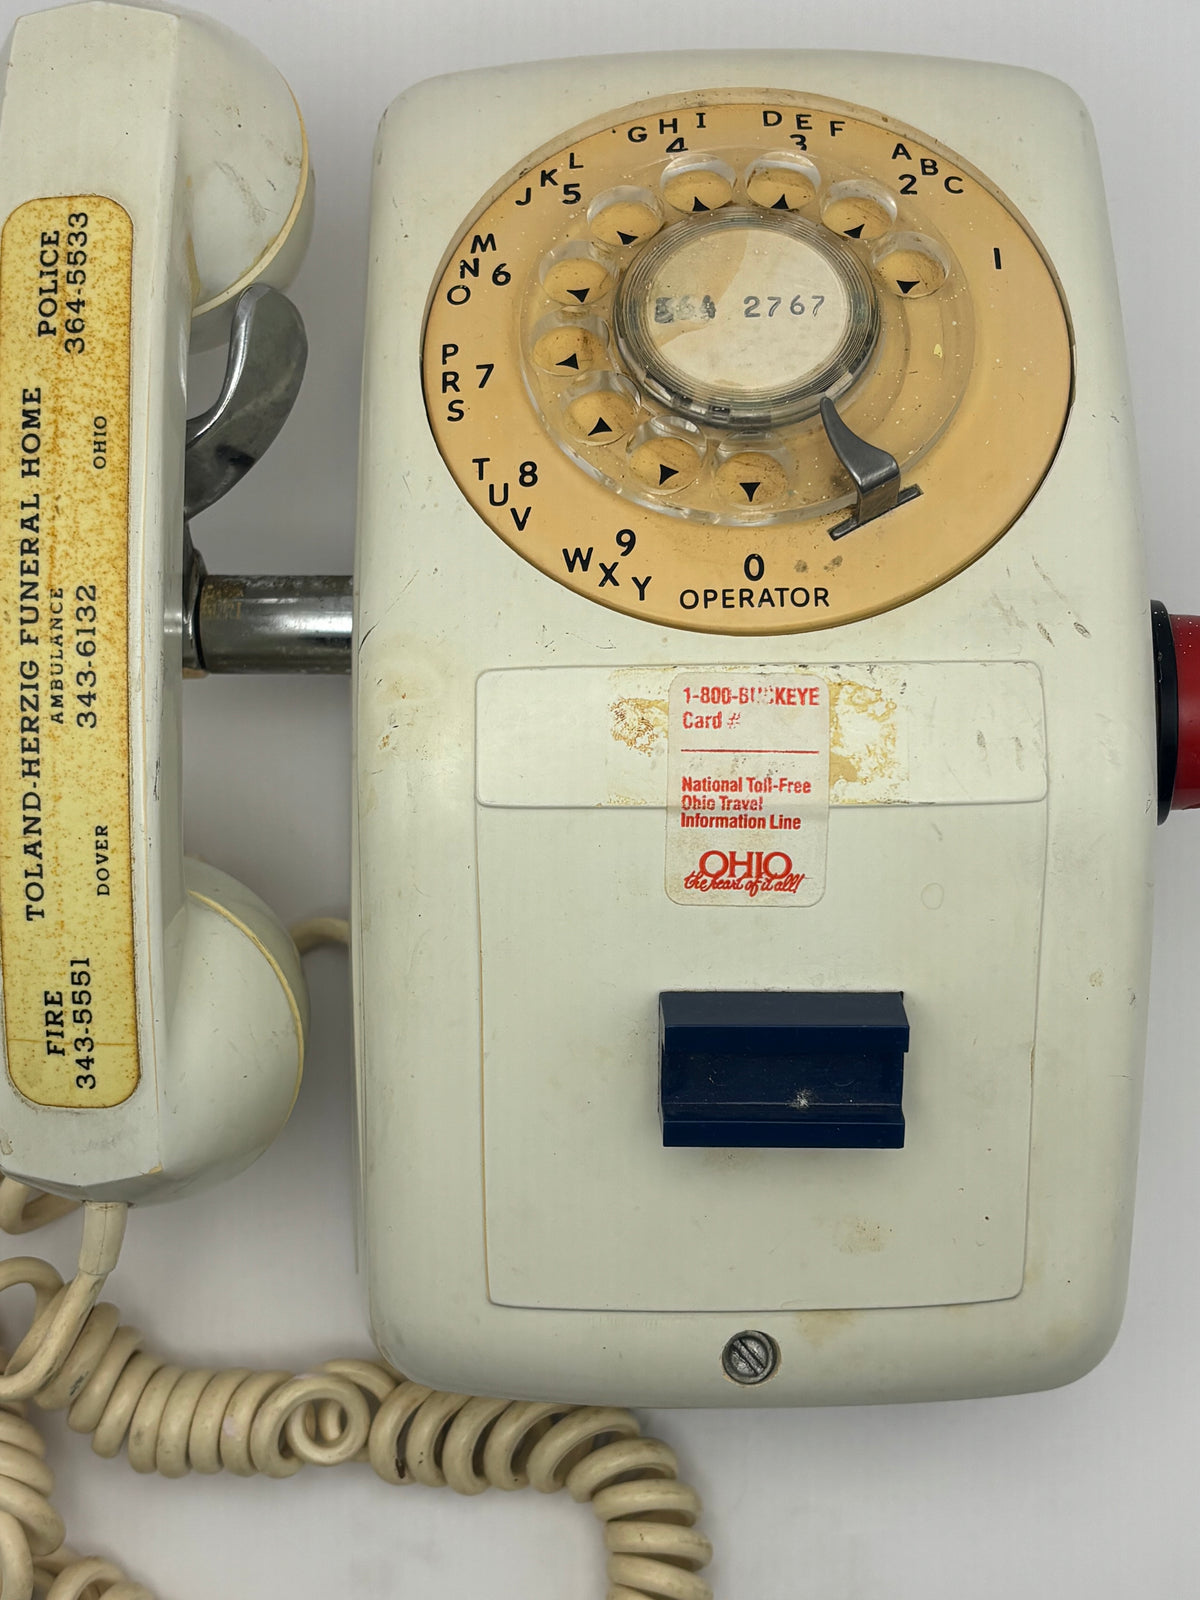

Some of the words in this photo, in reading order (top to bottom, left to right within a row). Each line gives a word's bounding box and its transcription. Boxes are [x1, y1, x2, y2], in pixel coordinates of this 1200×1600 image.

[666, 138, 688, 153] 4
[790, 133, 807, 150] 3
[562, 184, 582, 205] 5
[899, 174, 917, 195] 2
[38, 230, 60, 337] POLICE
[65, 212, 89, 354] 364-5533
[492, 263, 511, 286] 6
[743, 295, 825, 318] 2767
[476, 364, 494, 388] 7
[21, 387, 41, 479] HOME
[93, 416, 107, 470] OHIO
[519, 461, 538, 487] 8
[616, 529, 636, 556] 9
[19, 493, 40, 646] FUNERAL
[680, 587, 830, 609] OPERATOR
[50, 588, 65, 725] AMBULANCE
[76, 584, 97, 729] 343-6132
[682, 711, 722, 729] Card
[19, 659, 45, 922] TOLAND-HERZIG
[681, 775, 743, 793] National
[746, 777, 811, 794] Toll-Free
[681, 795, 716, 811] Ohio
[719, 795, 763, 811] Travel
[681, 813, 766, 829] Information
[769, 814, 801, 830] Line
[96, 825, 109, 897] DOVER
[698, 850, 793, 880] OHIO
[684, 870, 709, 892] the
[708, 869, 744, 890] heart
[744, 879, 761, 898] of
[760, 872, 774, 891] it
[774, 873, 805, 894] all!
[45, 990, 66, 1057] FIRE
[71, 957, 96, 1090] 343-5551
